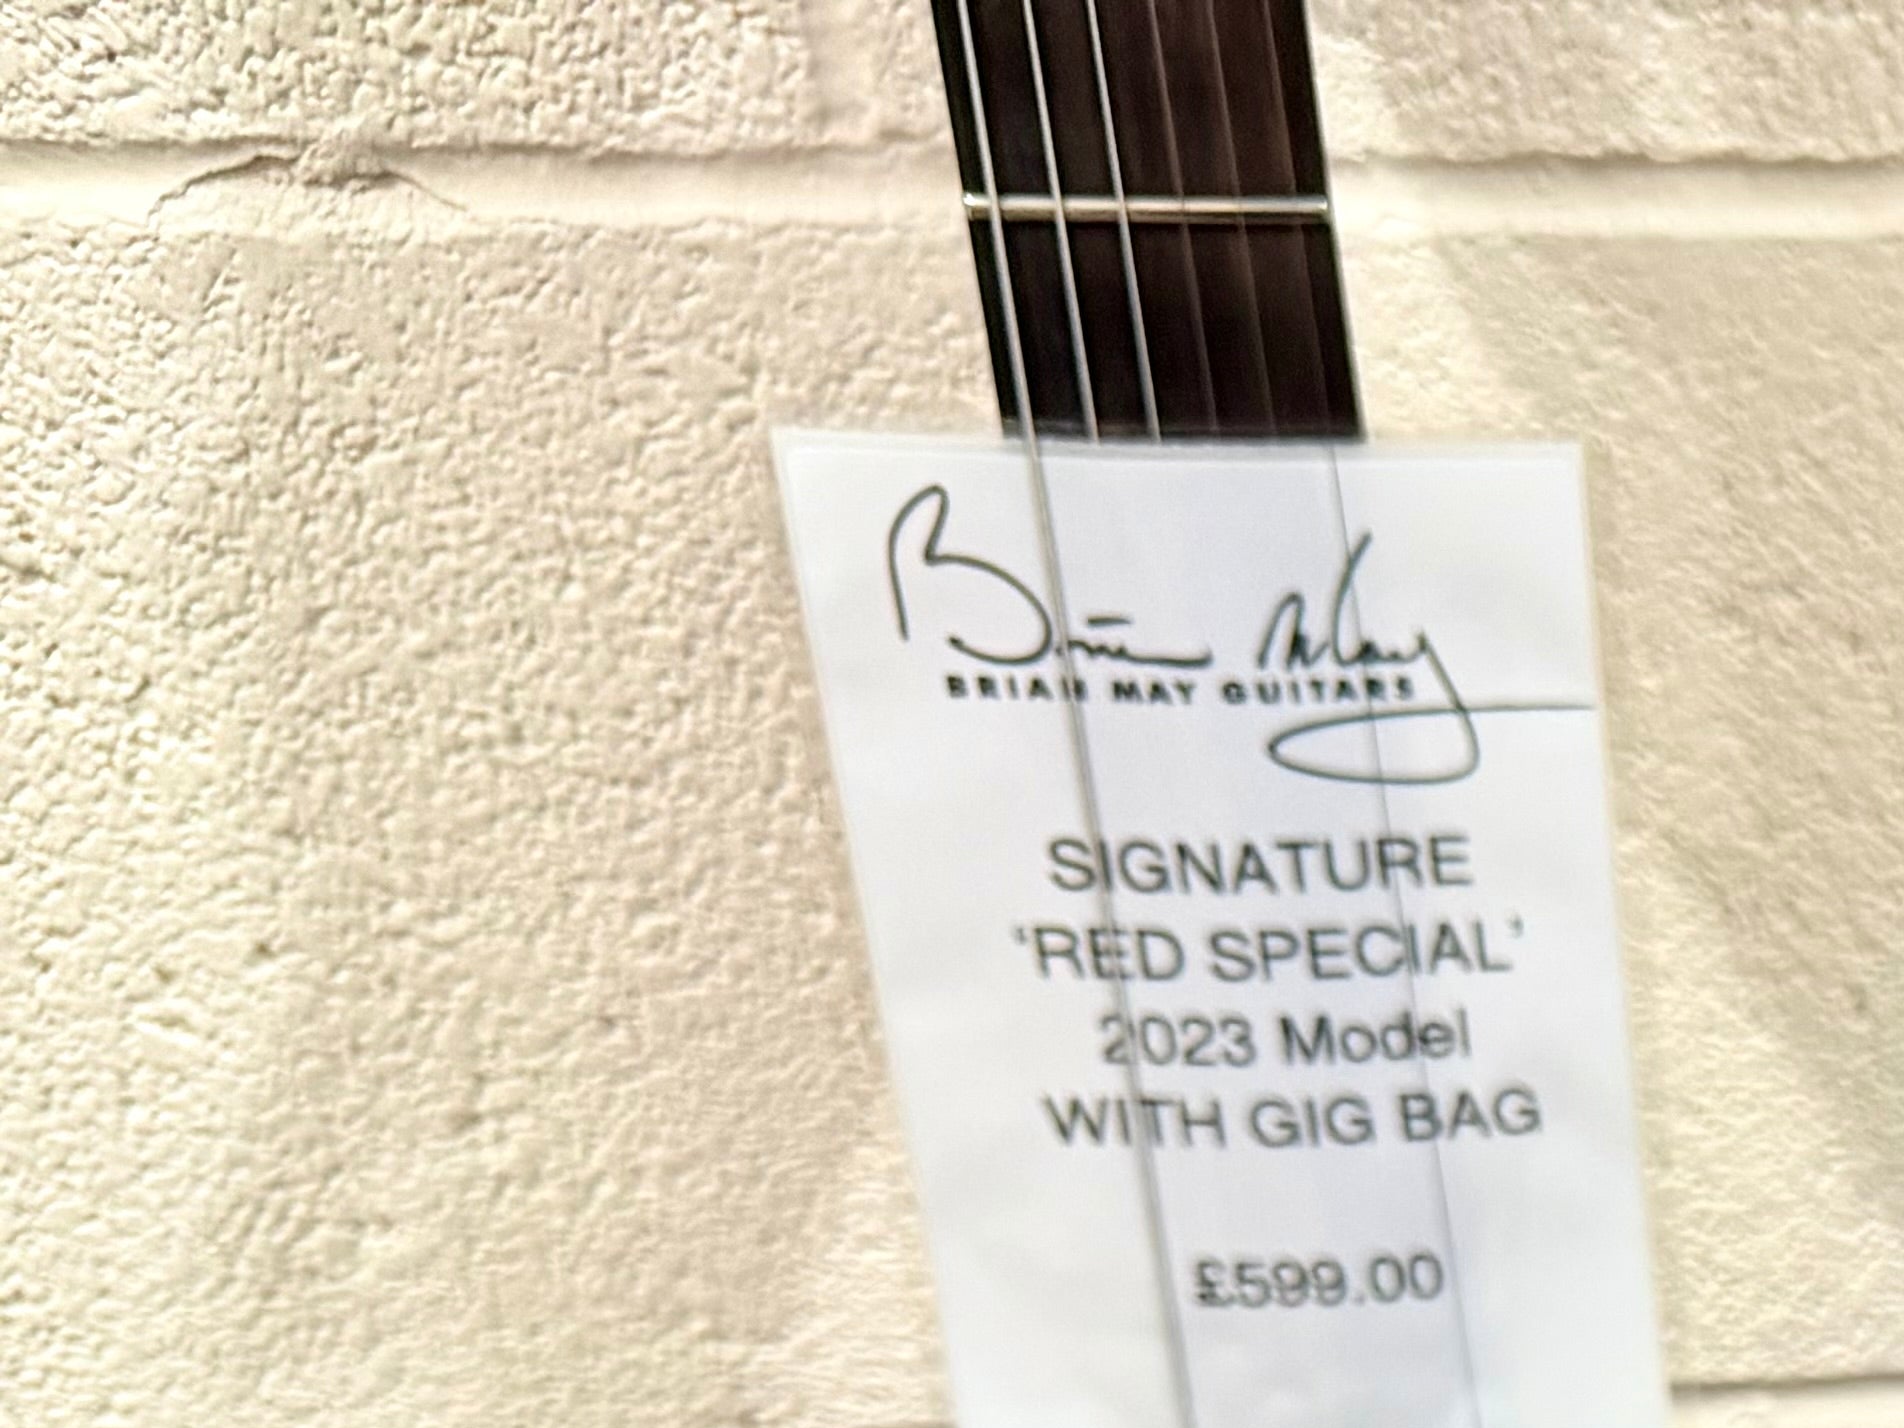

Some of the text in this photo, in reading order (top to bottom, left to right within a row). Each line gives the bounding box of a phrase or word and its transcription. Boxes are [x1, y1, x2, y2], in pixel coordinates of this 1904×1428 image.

[946, 673, 1416, 704] BRIAN MAY GUITARS
[1047, 833, 1474, 895] SIGNATURE
[1100, 1005, 1471, 1067] 2023 Model
[1041, 1086, 1544, 1149] WITH GIG BAG
[1194, 1250, 1445, 1311] £599.00
